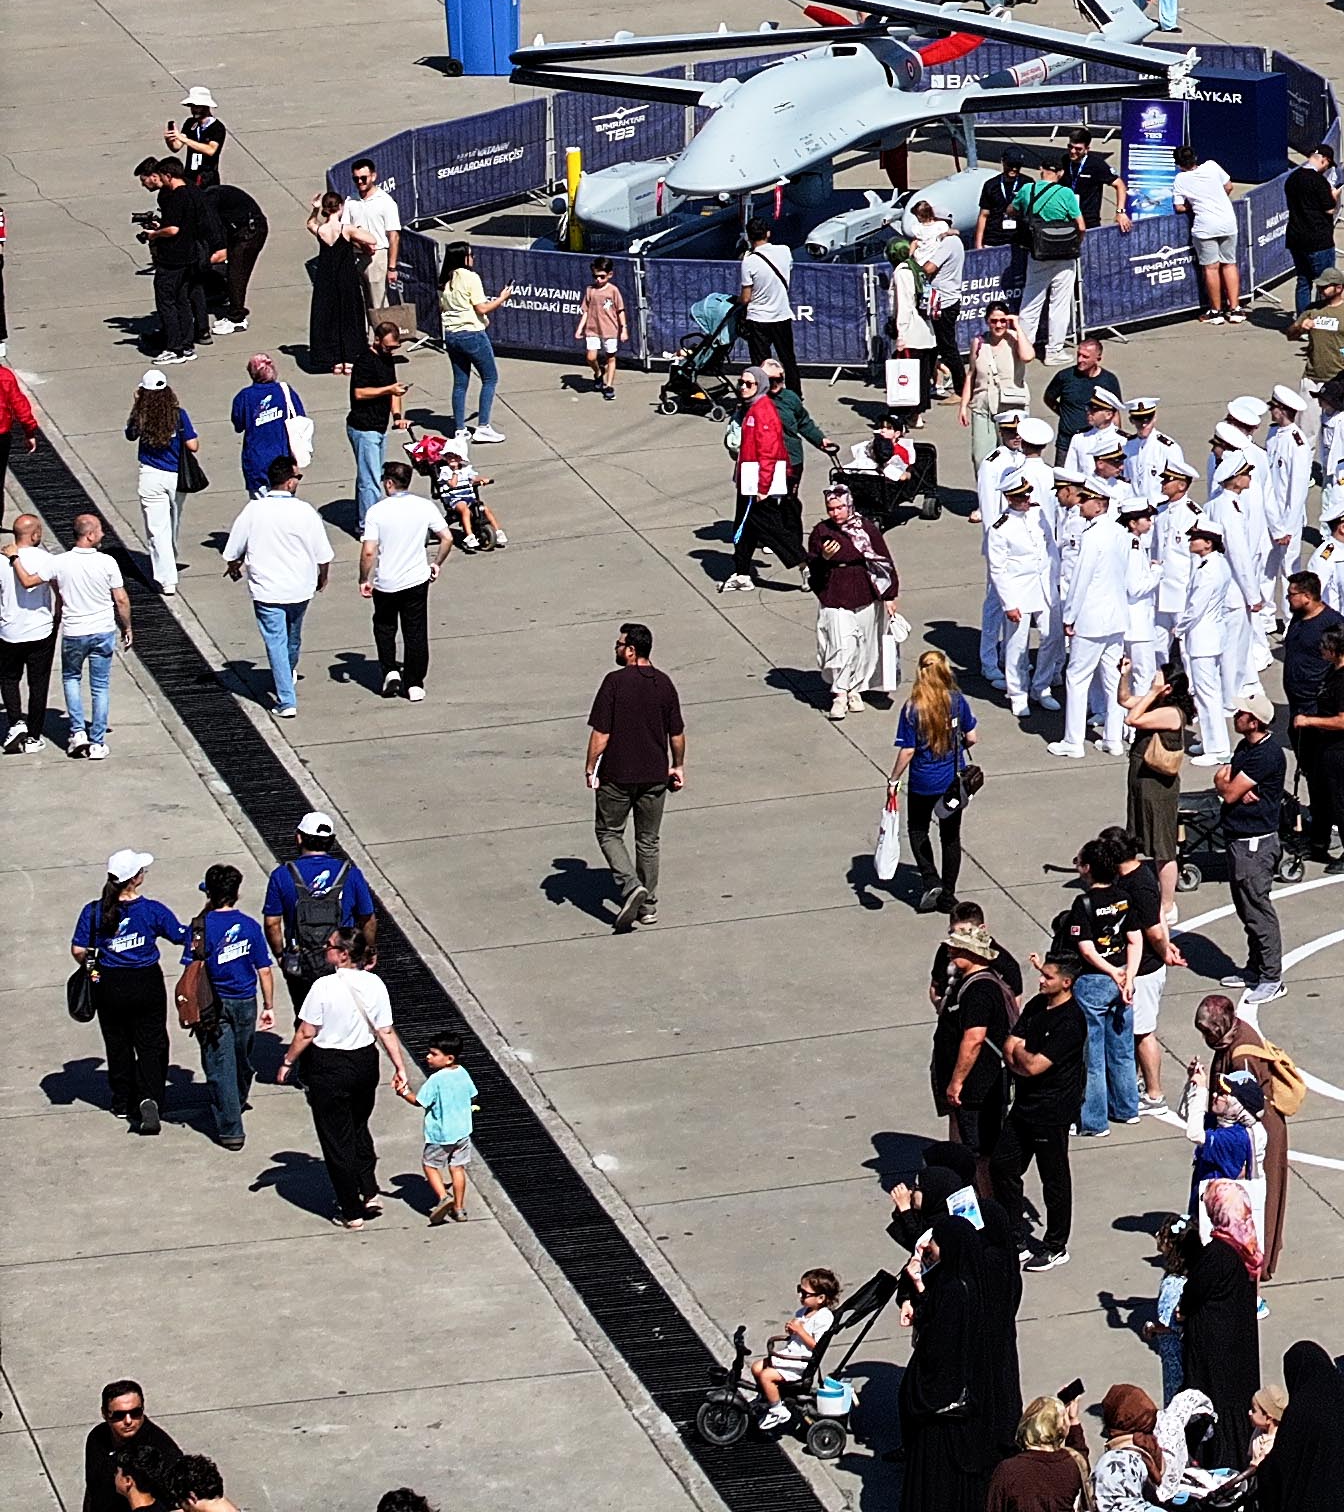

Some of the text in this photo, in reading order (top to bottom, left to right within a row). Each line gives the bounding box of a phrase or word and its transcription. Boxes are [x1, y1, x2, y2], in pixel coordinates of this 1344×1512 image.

[606, 125, 635, 142] TB3
[970, 276, 1000, 290] BLUE
[1146, 267, 1187, 286] TB3
[533, 286, 581, 301] VATANIN
